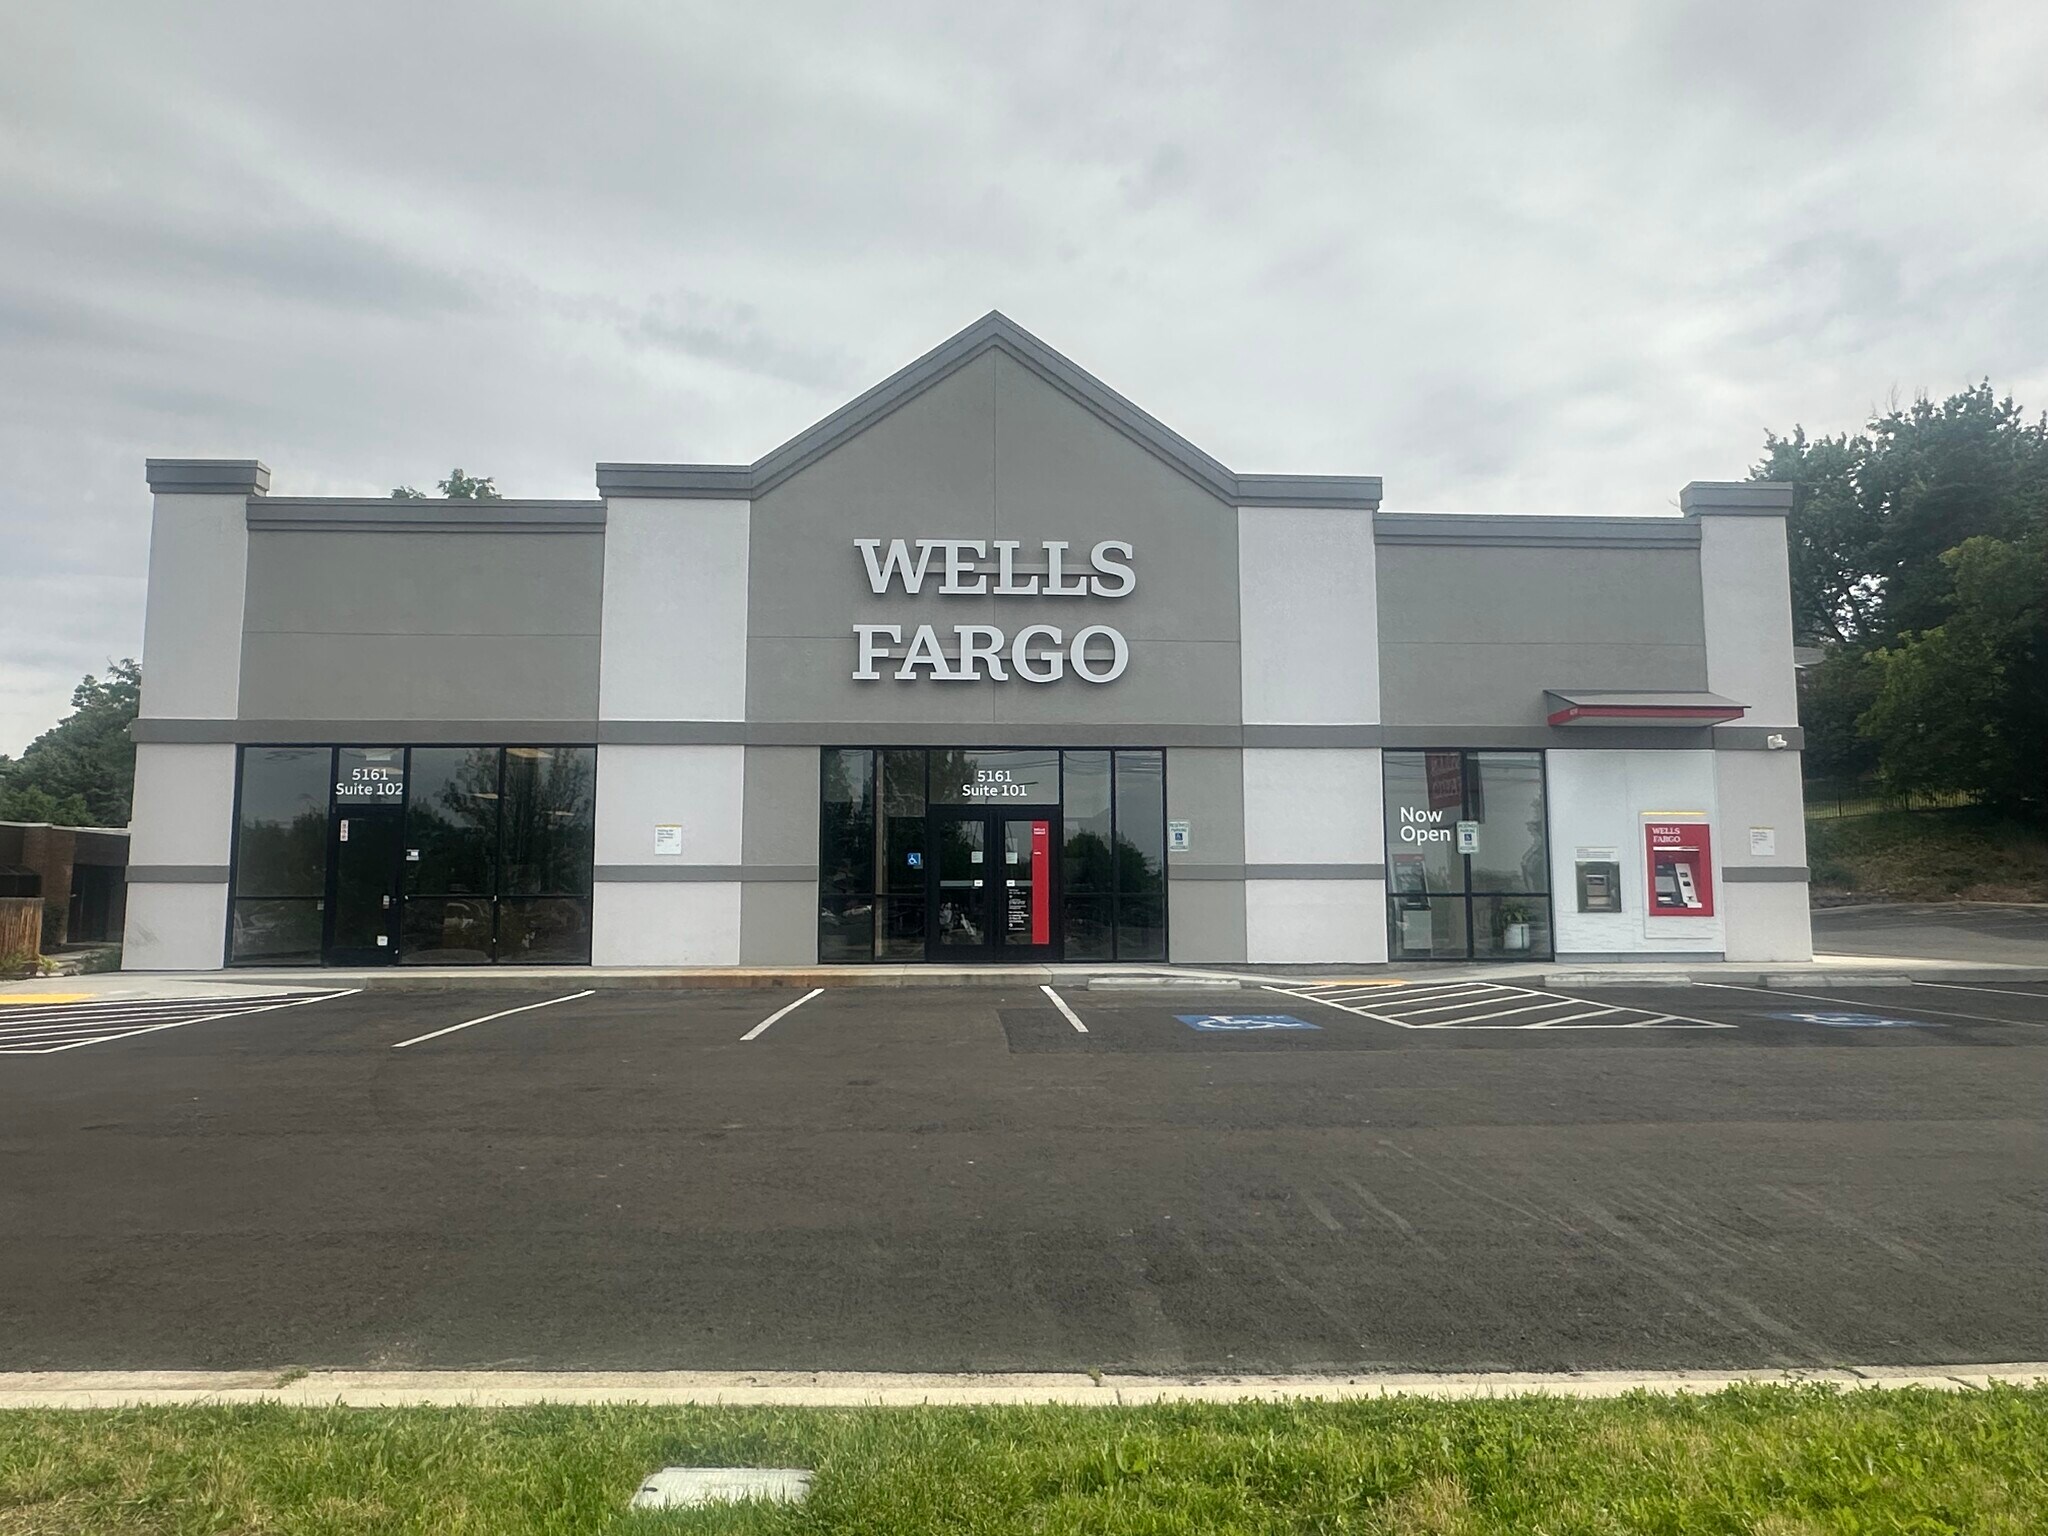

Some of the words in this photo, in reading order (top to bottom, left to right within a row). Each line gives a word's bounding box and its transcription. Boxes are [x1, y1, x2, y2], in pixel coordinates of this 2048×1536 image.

[853, 538, 1136, 598] WELLS
[852, 623, 1129, 683] FARGO
[351, 768, 389, 781] 5161
[977, 770, 1013, 783] 5161
[335, 782, 374, 796] Suite
[376, 782, 404, 795] 102
[962, 784, 999, 797] Suite
[1001, 784, 1028, 797] 101
[1400, 806, 1443, 823] Now
[1400, 825, 1451, 846] Open
[1651, 827, 1681, 835] WELLS
[1652, 835, 1681, 843] FARGO
